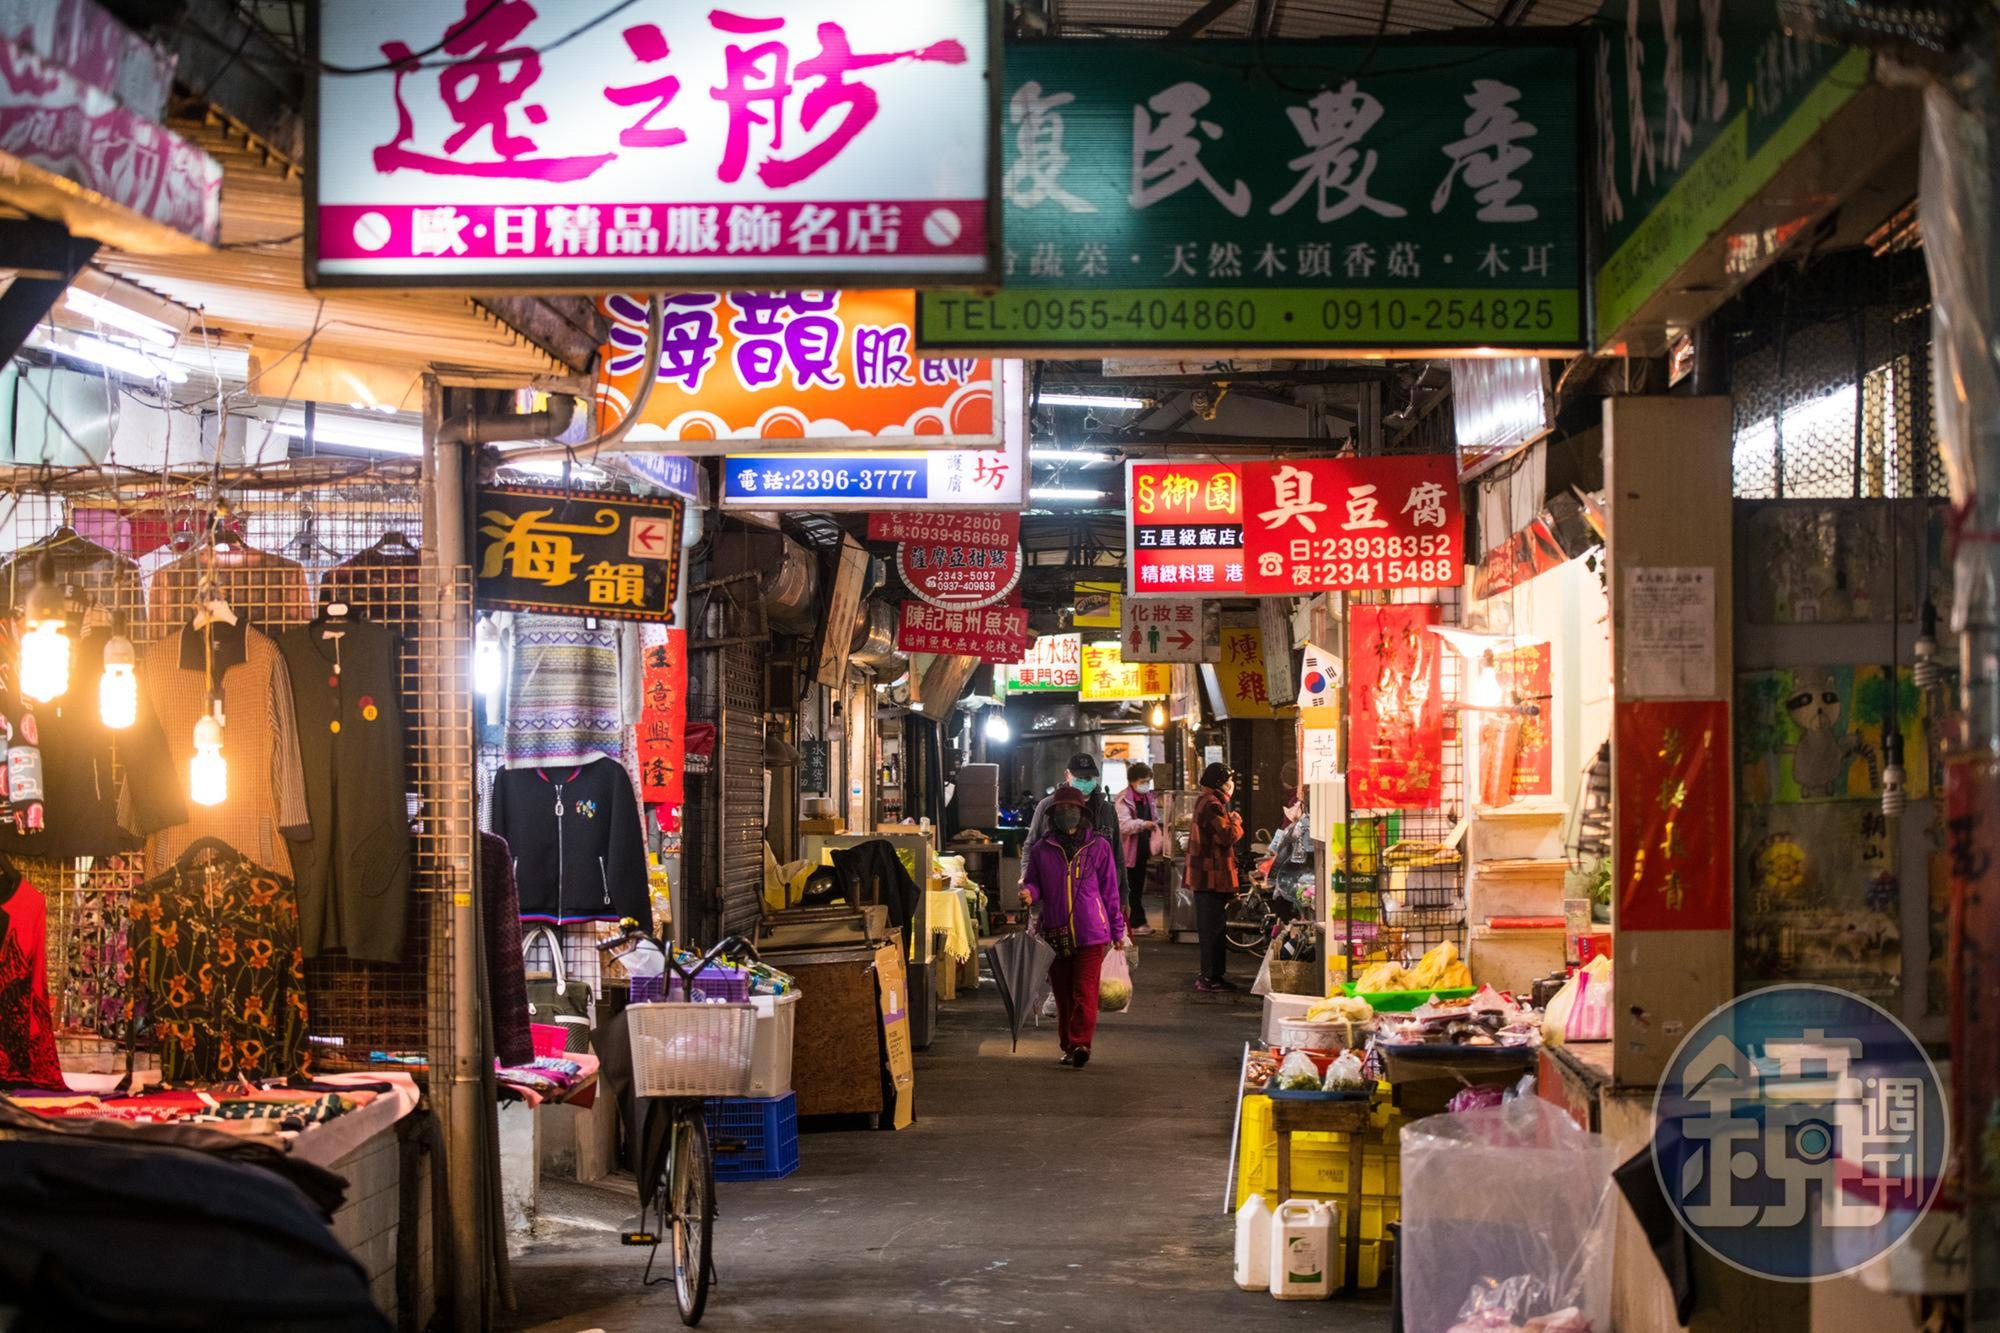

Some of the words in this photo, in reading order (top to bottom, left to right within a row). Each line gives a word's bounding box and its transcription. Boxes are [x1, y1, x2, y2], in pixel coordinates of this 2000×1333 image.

[942, 299, 1256, 332] TEL:0955-404860
[1322, 299, 1554, 331] 0910-254825
[737, 469, 918, 492] 電話:2396-3777
[1257, 465, 1448, 534] 臭豆腐
[879, 523, 1009, 546] 手機:0939-858698
[479, 507, 646, 607] 海韻
[910, 546, 1008, 569] 薩摩亞甜點
[1290, 534, 1451, 562] 日:23938352
[937, 571, 996, 581] 2343-5097
[1291, 560, 1452, 586] 夜:23415488
[905, 604, 1021, 637] 陳記福州魚丸
[1130, 604, 1194, 622] 化妝室
[1019, 668, 1079, 686] 東門3色
[643, 645, 675, 787] 生意興隆
[1338, 876, 1372, 884] LMON
